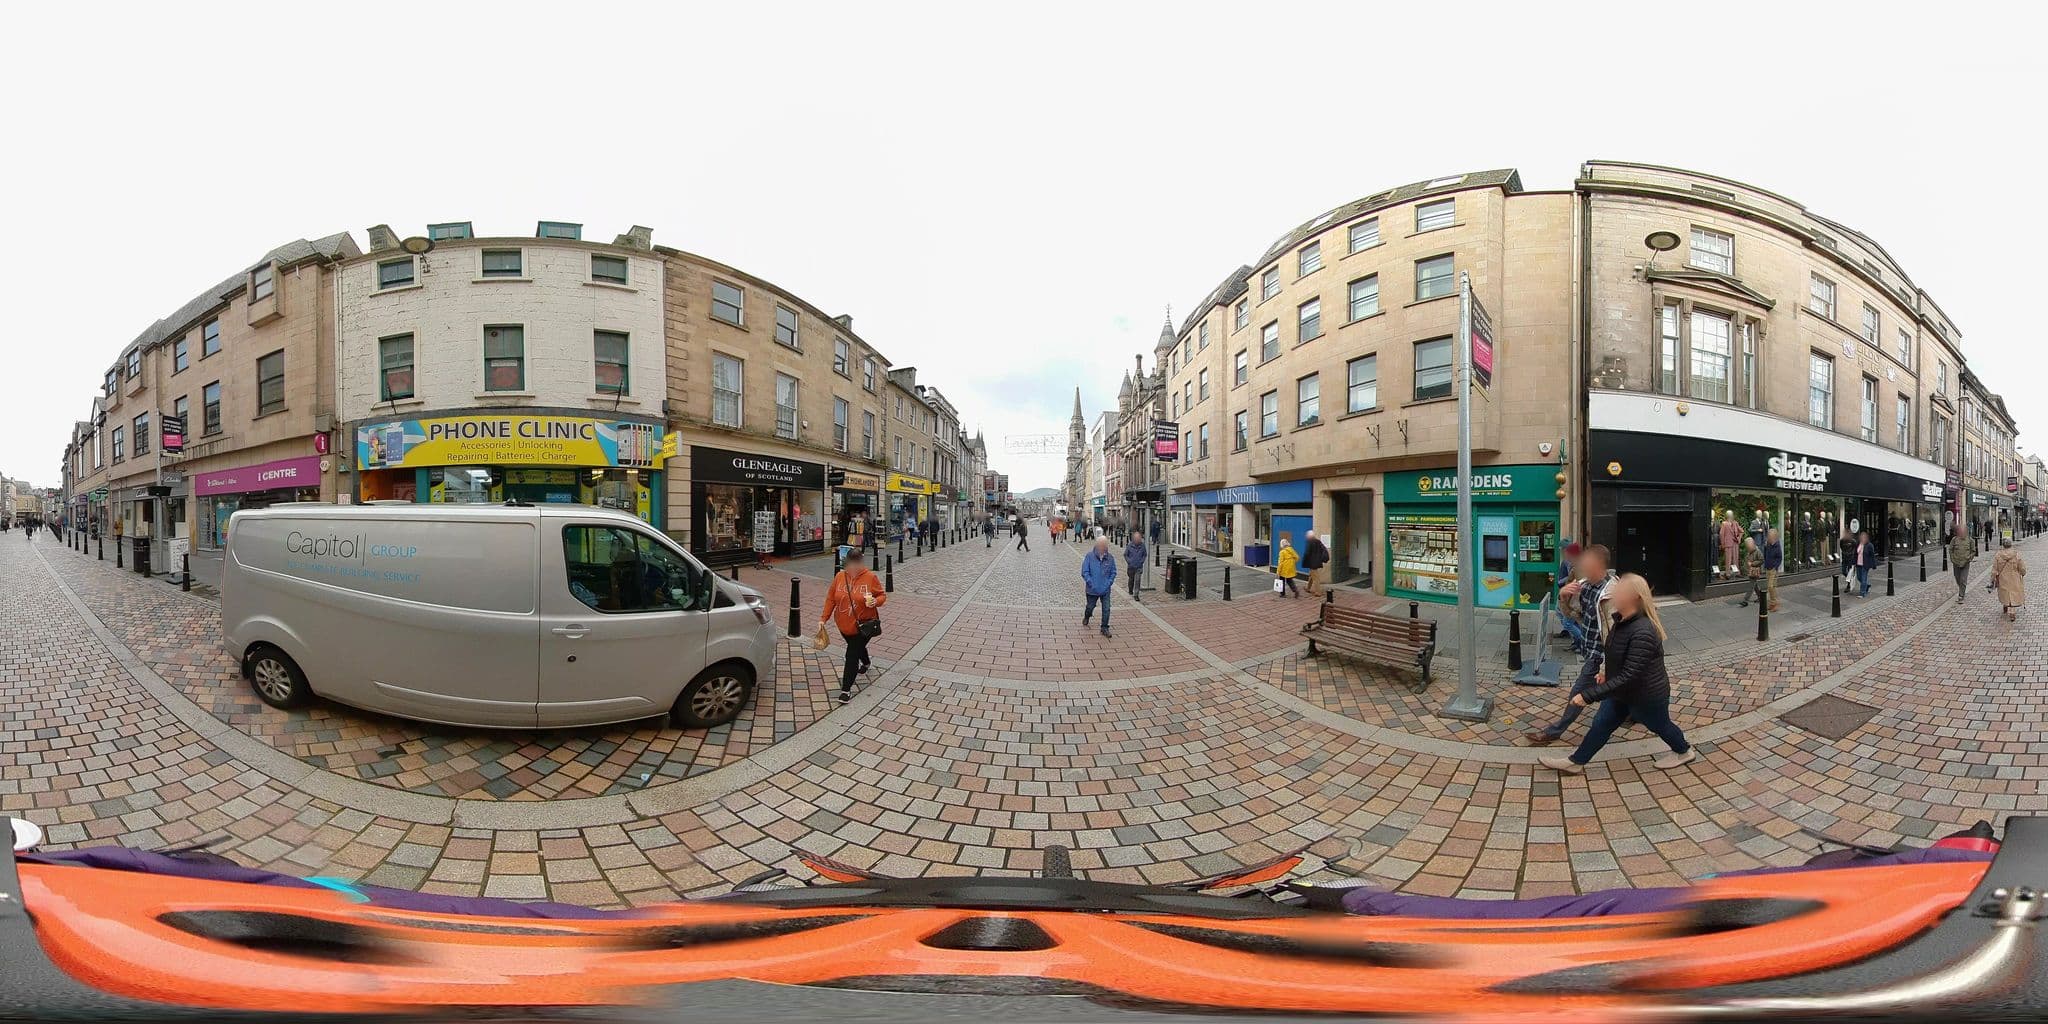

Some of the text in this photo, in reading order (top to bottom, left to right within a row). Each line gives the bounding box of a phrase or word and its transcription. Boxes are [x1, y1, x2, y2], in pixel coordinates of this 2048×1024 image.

[430, 420, 593, 441] PHONE CLINIC
[460, 440, 563, 451] Accessories Unlocking
[447, 452, 577, 462] Repairing Batteries Charger
[262, 468, 297, 480] CENTRE
[732, 457, 802, 475] GLENEAGLES
[1767, 452, 1831, 482] slater
[1776, 479, 1824, 492] MENSWEAR
[1921, 480, 1943, 497] slater
[1216, 486, 1260, 504] WHSmith
[286, 531, 417, 560] Capitol GROUP
